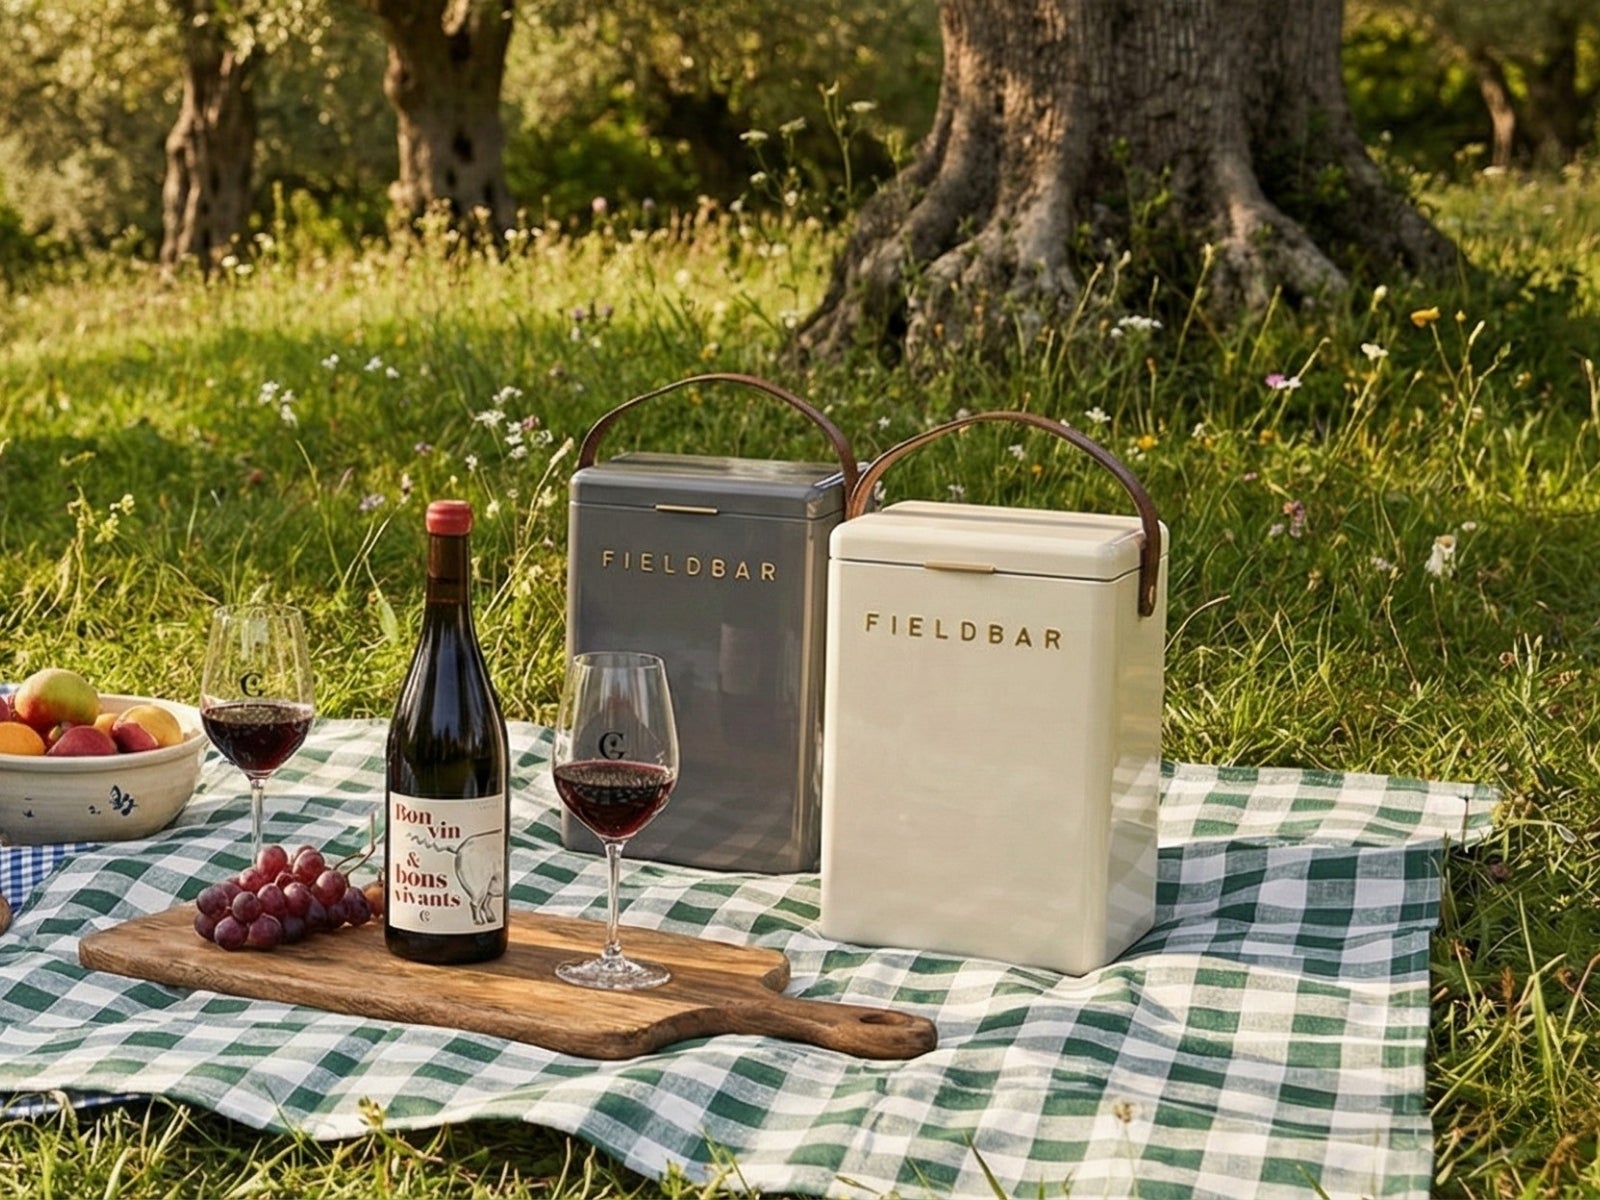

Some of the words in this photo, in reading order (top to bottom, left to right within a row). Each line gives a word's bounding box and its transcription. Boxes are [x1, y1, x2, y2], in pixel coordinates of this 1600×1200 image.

[602, 550, 776, 582] FIELDBAR
[865, 612, 1062, 650] FIELDBAR
[395, 803, 432, 825] Bon
[427, 821, 461, 839] vin
[406, 851, 420, 868] &
[395, 863, 448, 888] bons
[394, 886, 461, 907] vivants
